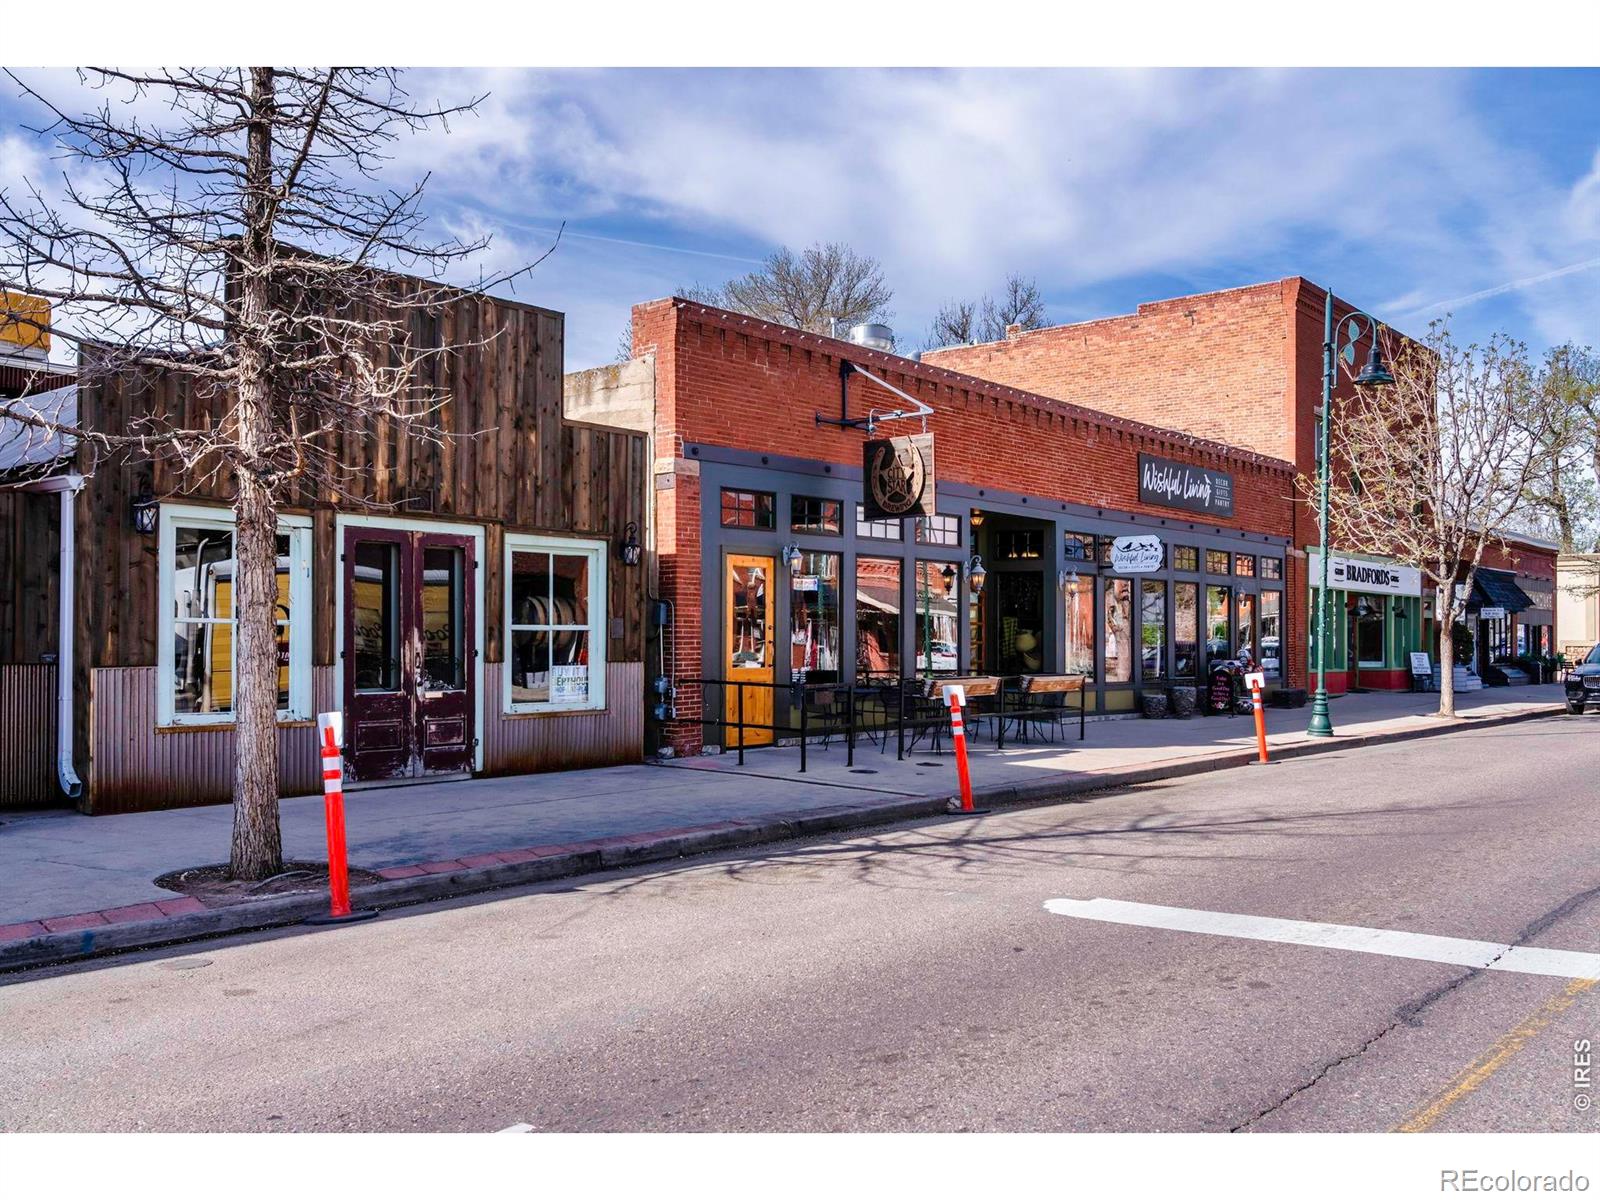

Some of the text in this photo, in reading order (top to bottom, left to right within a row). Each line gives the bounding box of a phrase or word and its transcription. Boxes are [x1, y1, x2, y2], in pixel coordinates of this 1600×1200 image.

[888, 467, 905, 480] CITY
[888, 480, 906, 494] STAR
[1143, 462, 1212, 507] Wishful Living
[1214, 498, 1230, 508] PANTRY
[1346, 564, 1390, 586] BRADFORDS
